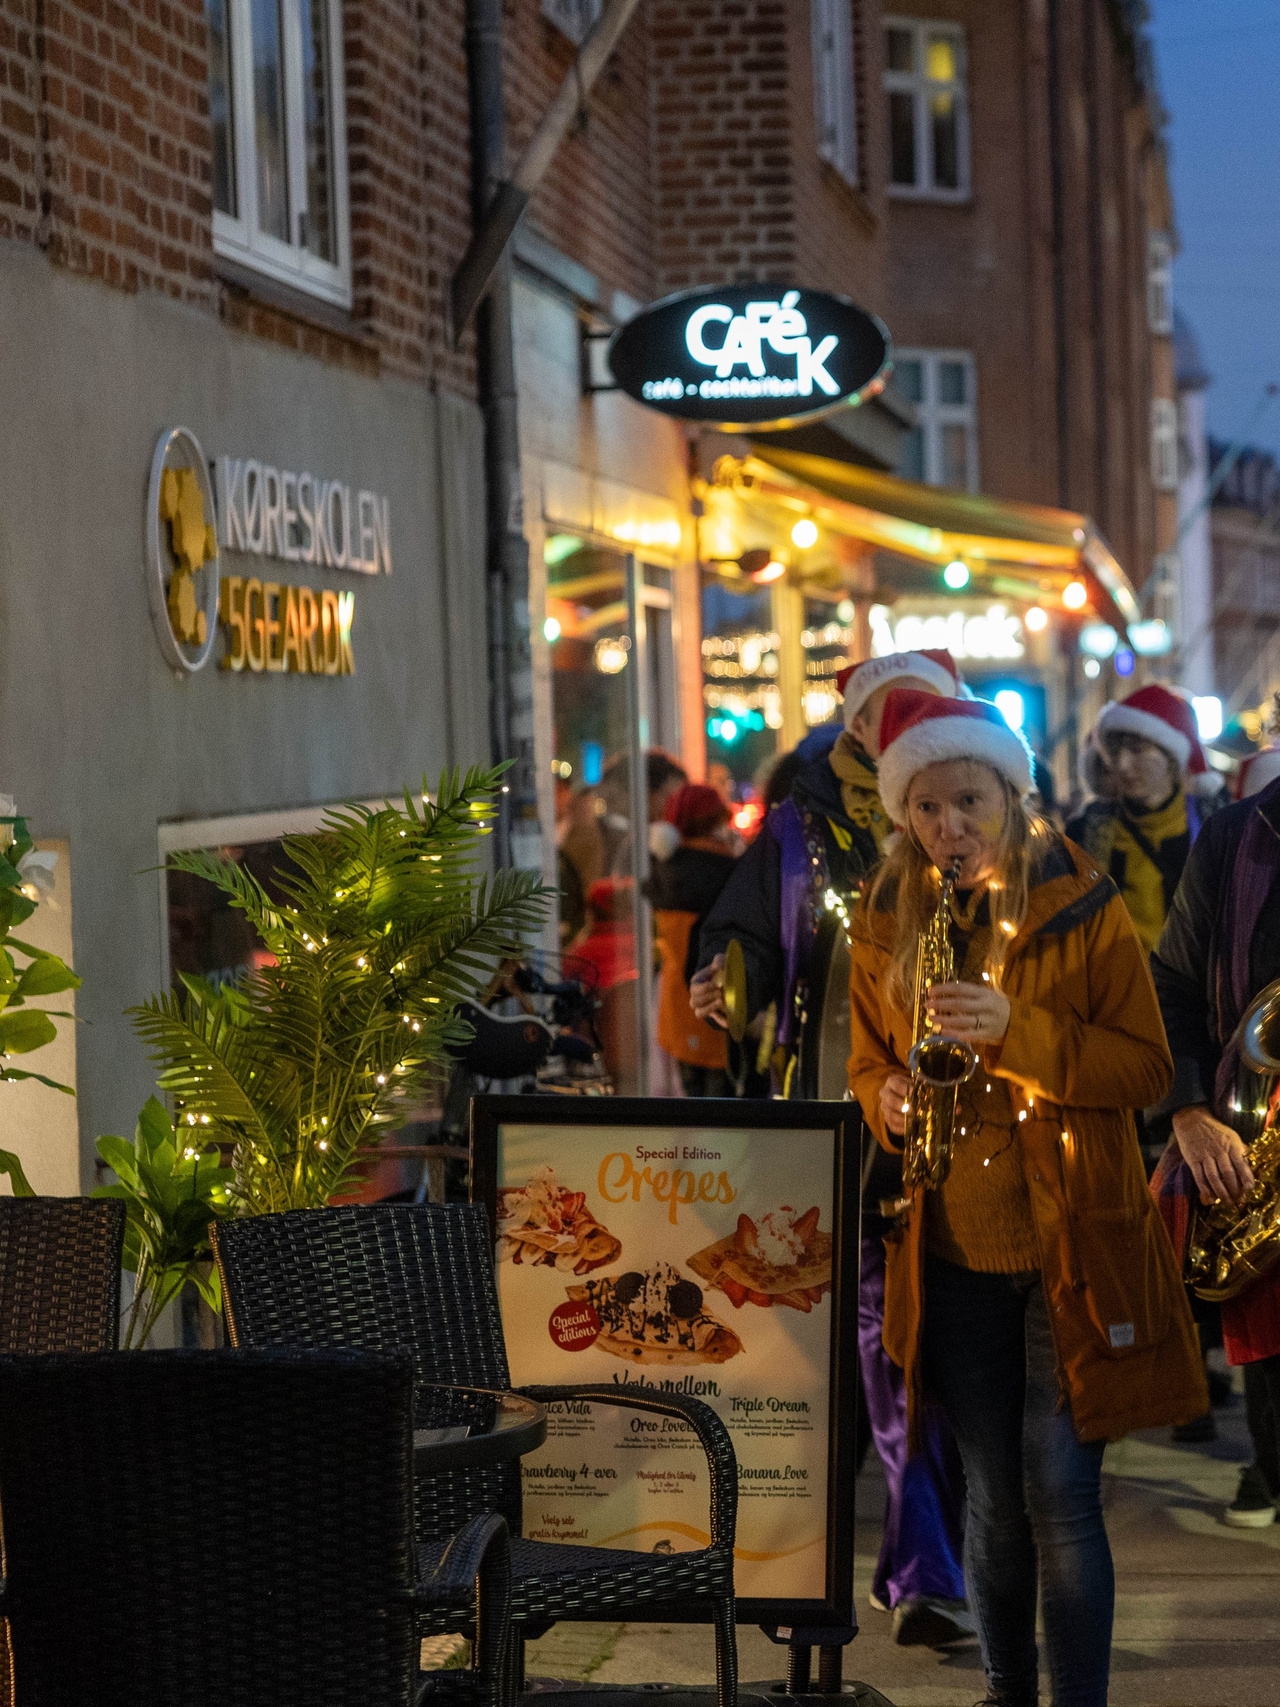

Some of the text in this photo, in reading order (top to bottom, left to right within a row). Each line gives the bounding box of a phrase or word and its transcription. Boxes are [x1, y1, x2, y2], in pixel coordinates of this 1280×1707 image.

[219, 455, 392, 577] KØRESKOLEN
[636, 1145, 721, 1162] Special Edition
[597, 1152, 738, 1225] Crepes
[552, 1309, 591, 1333] Special
[558, 1326, 597, 1343] editions
[659, 1375, 721, 1398] mellem
[564, 1400, 592, 1416] Vida
[729, 1397, 810, 1417] Triple Dream
[630, 1417, 659, 1433] Oreo
[520, 1463, 577, 1482] trawberry
[736, 1463, 809, 1480] Banana Love
